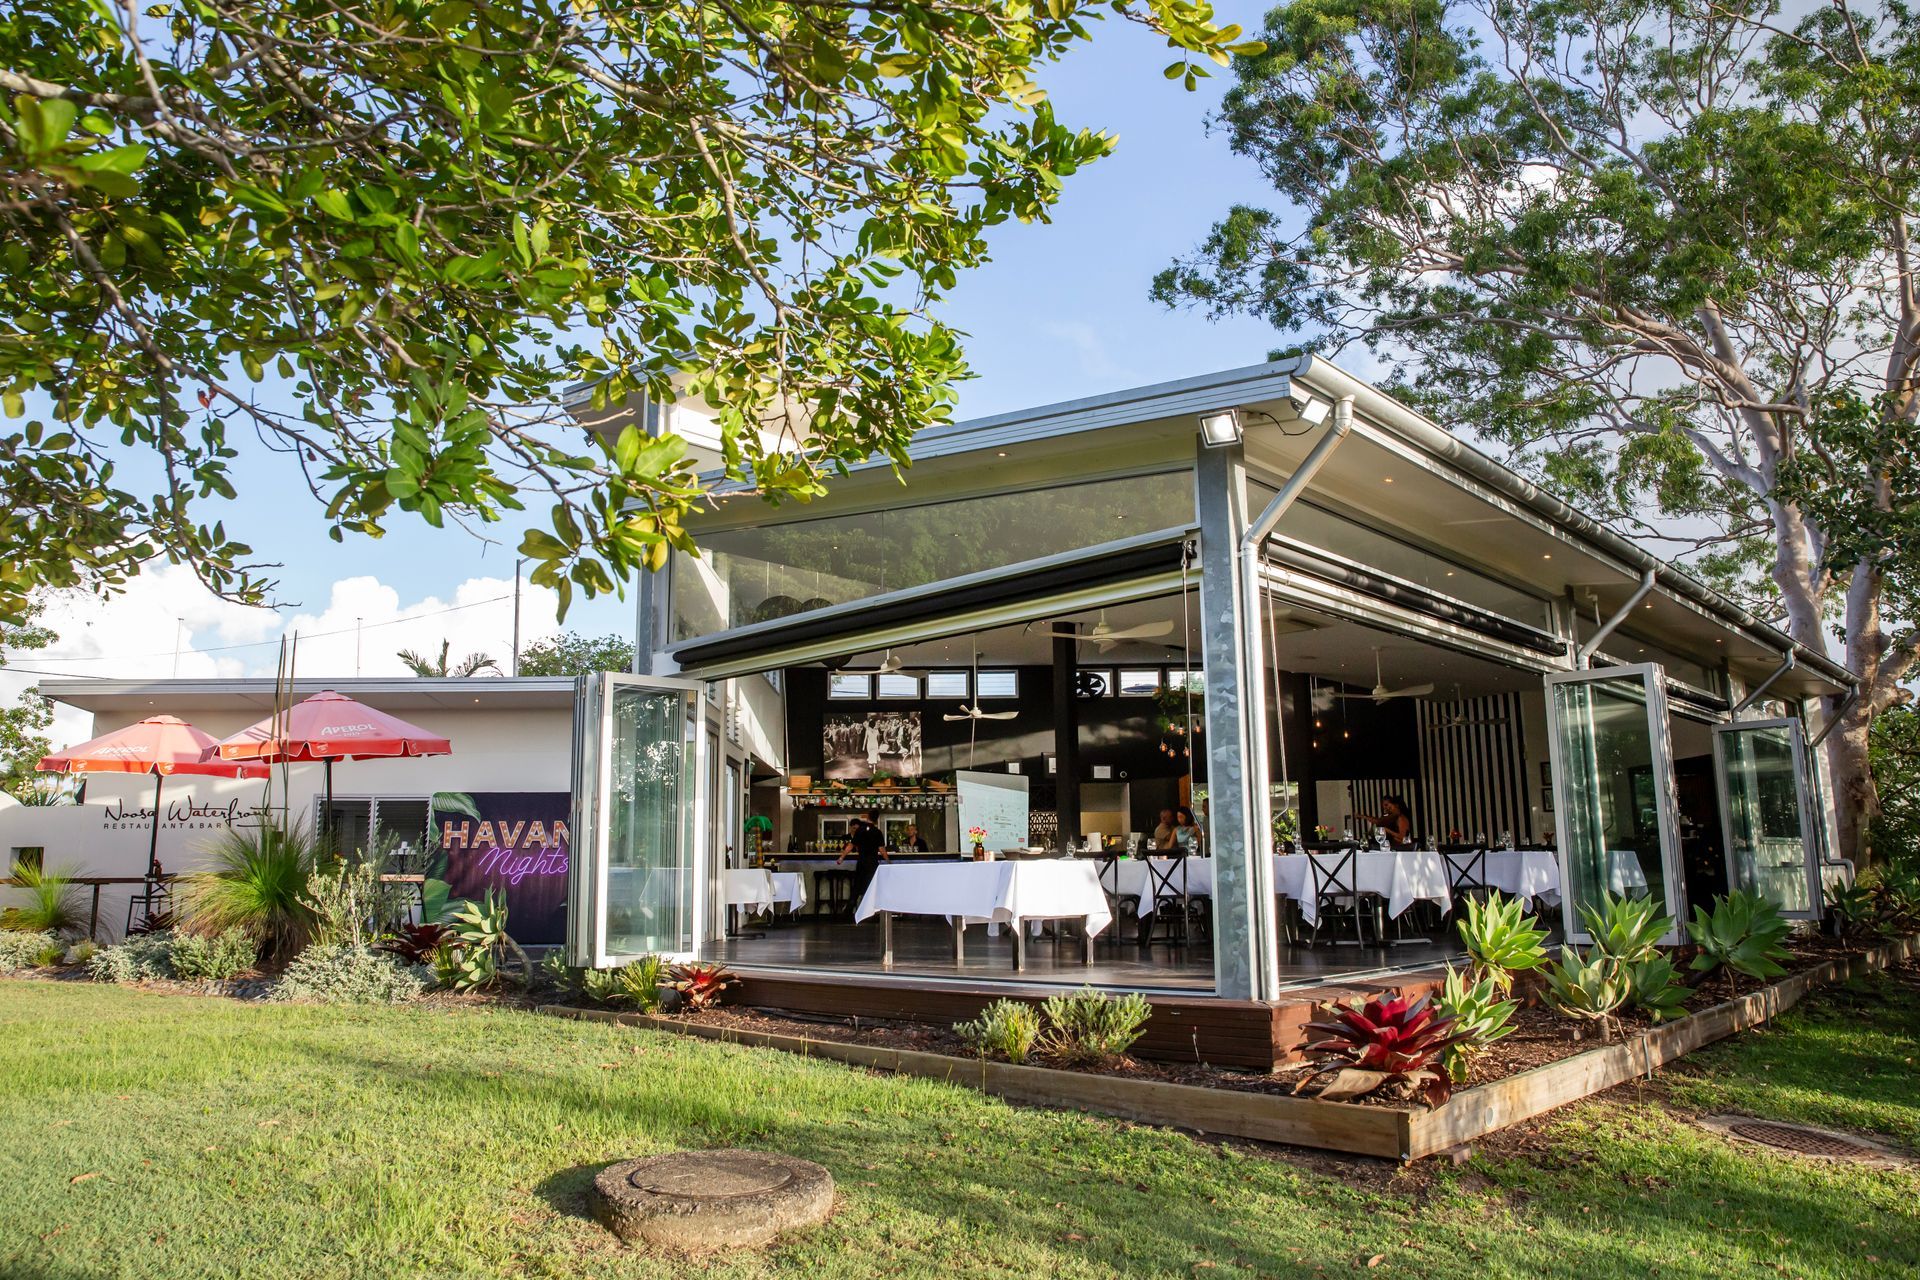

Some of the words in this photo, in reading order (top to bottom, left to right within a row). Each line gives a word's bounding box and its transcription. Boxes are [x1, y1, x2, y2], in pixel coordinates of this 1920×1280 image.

[321, 723, 377, 736] APEROL
[104, 798, 158, 821] Noosa
[103, 822, 185, 830] RESTAUANT
[478, 846, 569, 885] Nights
